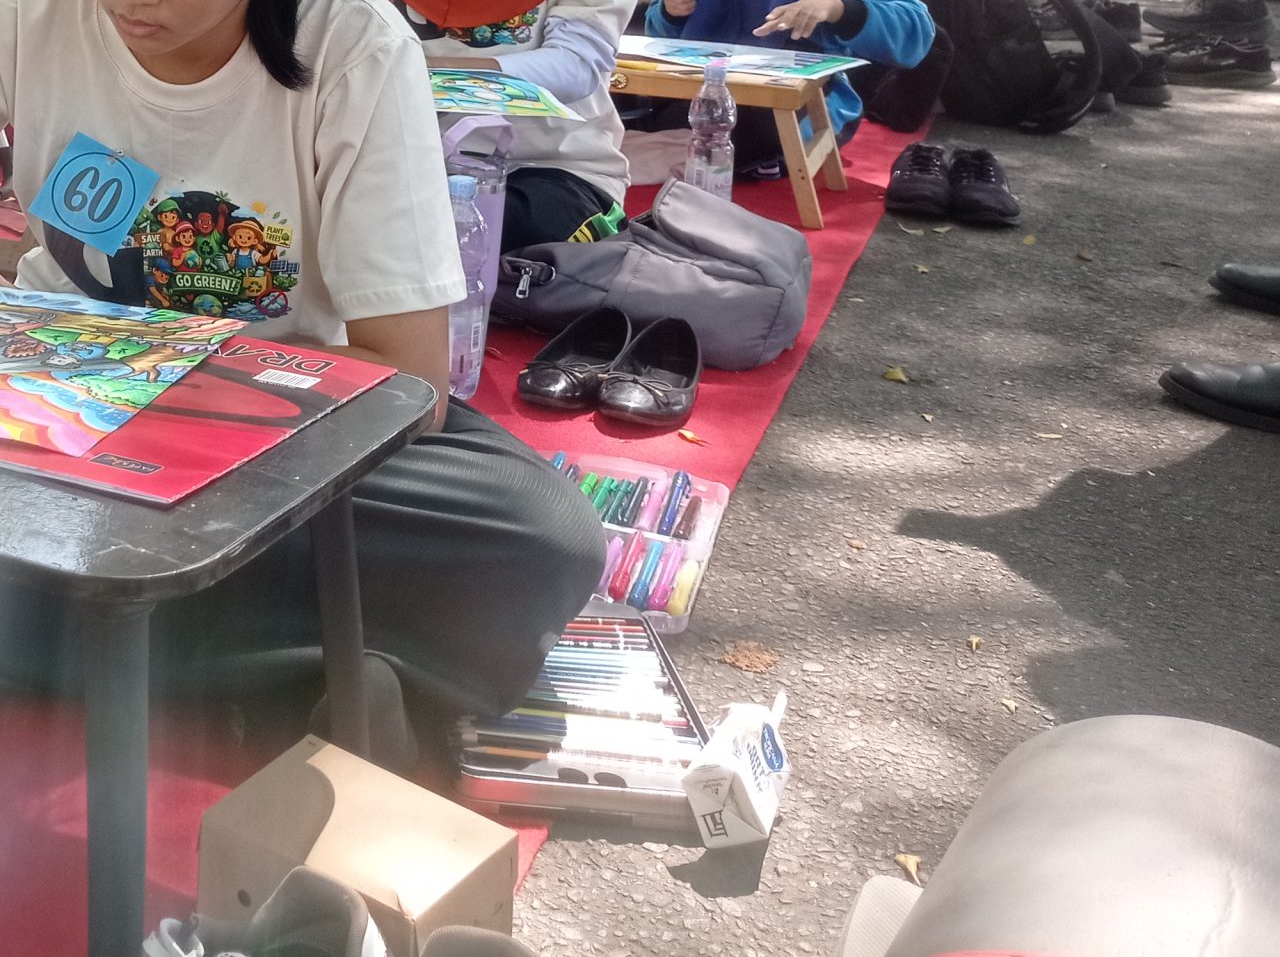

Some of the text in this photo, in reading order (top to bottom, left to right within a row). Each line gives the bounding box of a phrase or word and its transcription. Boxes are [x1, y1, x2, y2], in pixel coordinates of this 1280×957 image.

[63, 166, 123, 223] 60
[266, 226, 284, 235] PLANT
[141, 234, 161, 243] SAVE
[266, 233, 282, 242] TREES
[175, 273, 238, 292] GO GREEN!
